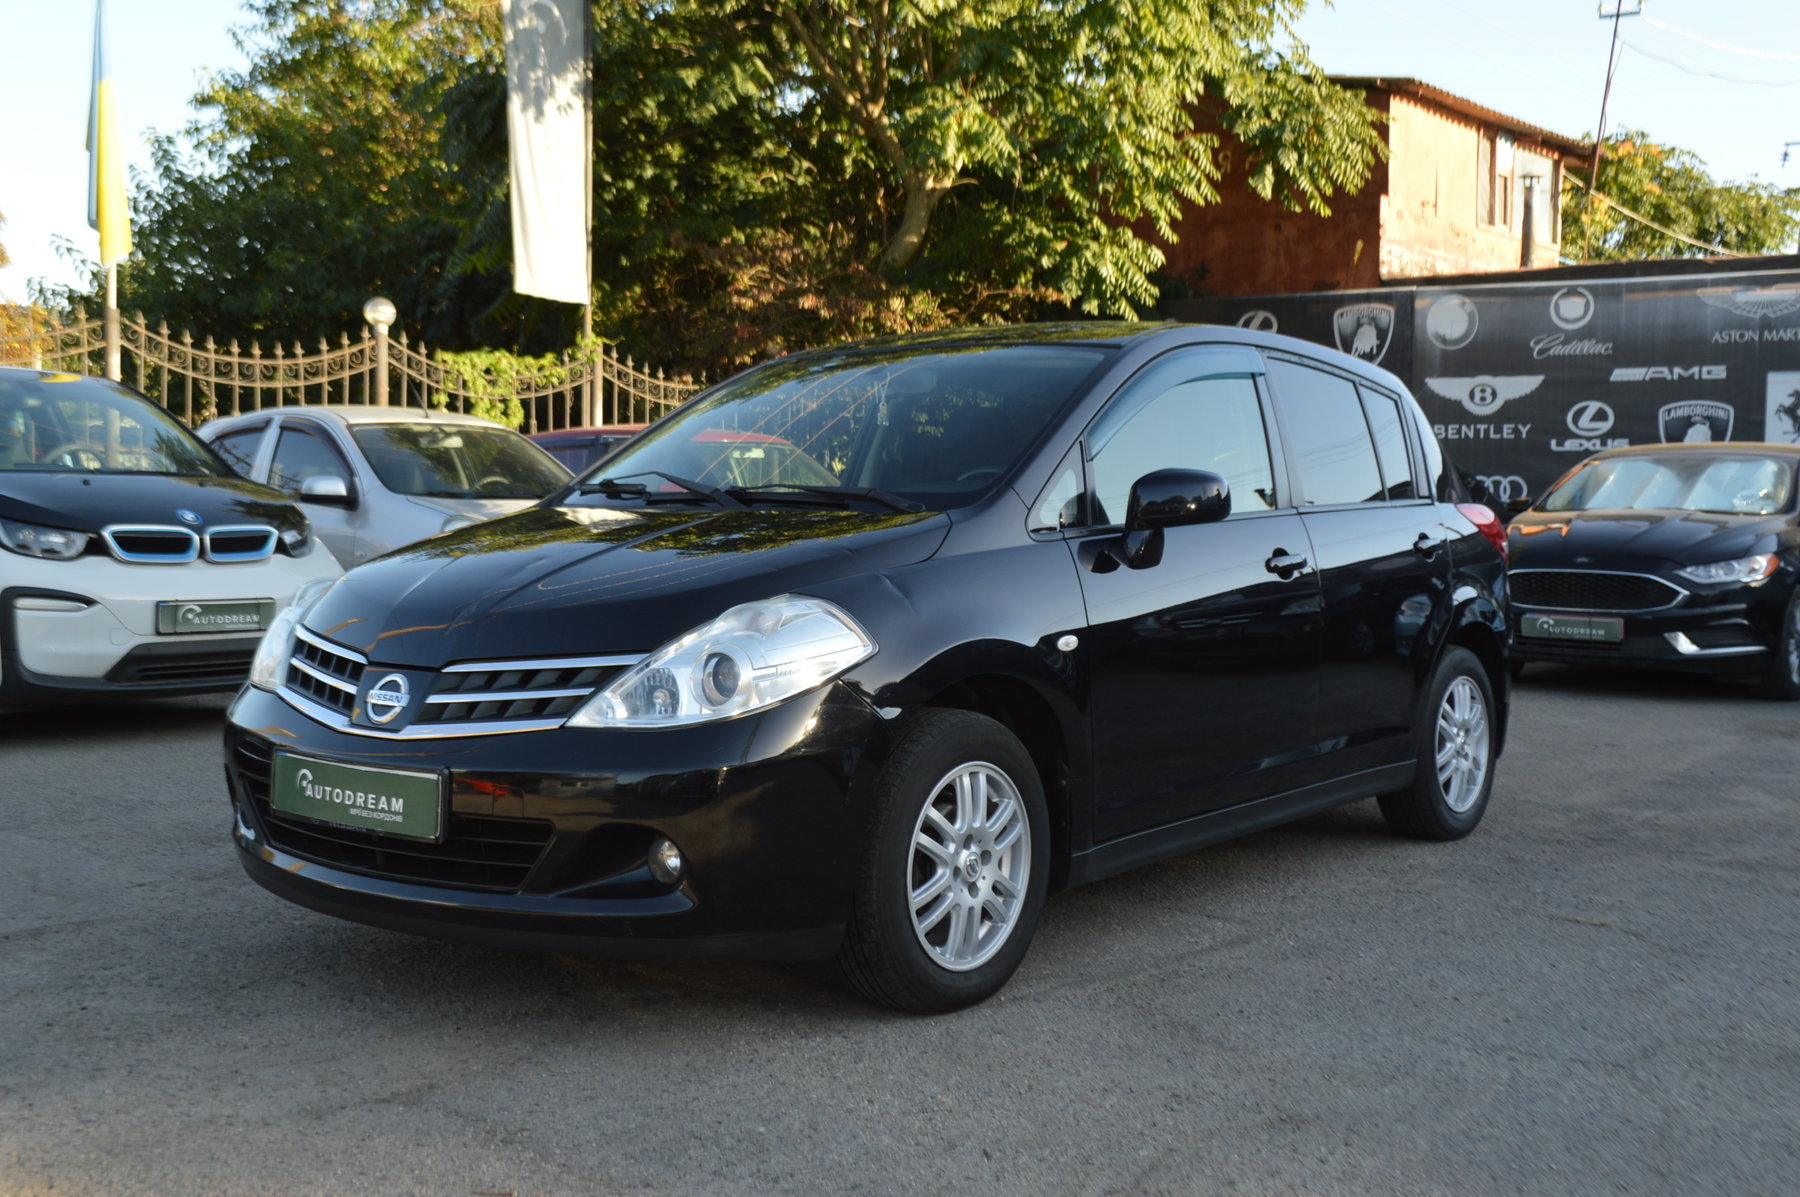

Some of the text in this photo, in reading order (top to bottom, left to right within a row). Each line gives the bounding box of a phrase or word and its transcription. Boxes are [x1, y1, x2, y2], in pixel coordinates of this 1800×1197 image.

[1712, 330, 1759, 344] ASTON
[1530, 333, 1613, 359] Cadillac
[1645, 365, 1727, 381] AMG
[1665, 405, 1728, 421] LAMBORGHINI
[1434, 423, 1531, 439] BENTLEY
[1551, 437, 1630, 452] LEXUS
[370, 692, 403, 704] NISSAN
[305, 783, 404, 812] AUTODREAM
